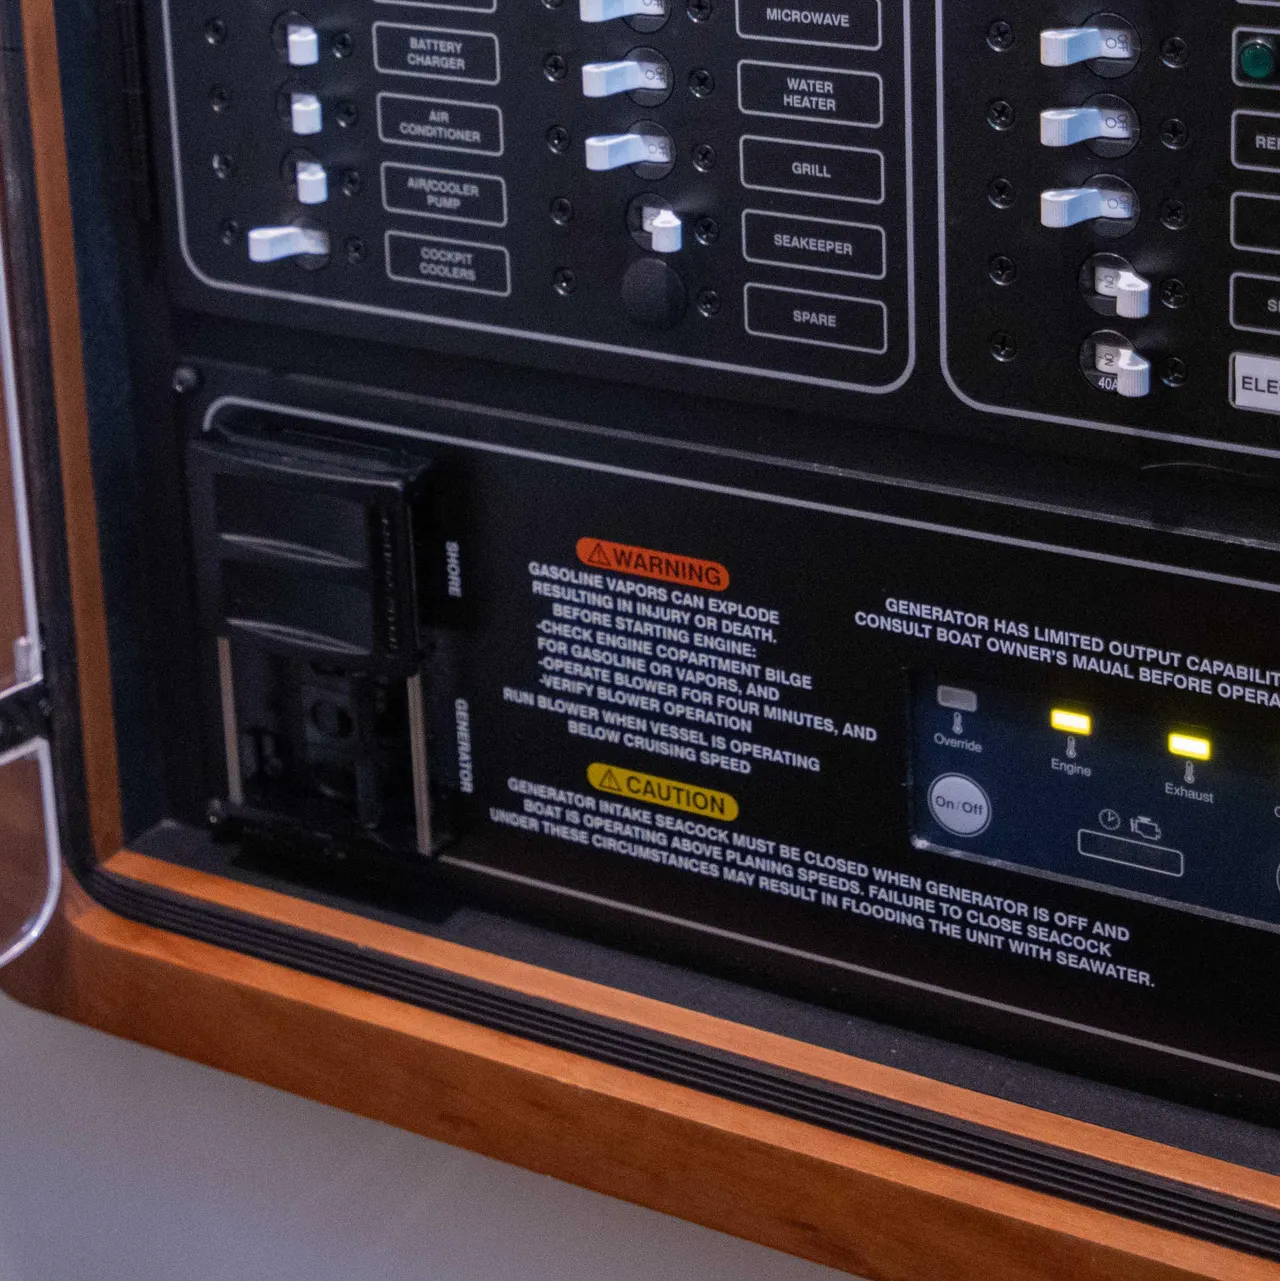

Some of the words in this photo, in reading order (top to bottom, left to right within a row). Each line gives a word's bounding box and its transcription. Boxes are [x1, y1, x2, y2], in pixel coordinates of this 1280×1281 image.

[766, 8, 850, 27] MICROWAVE
[410, 37, 463, 54] BATTERY
[407, 53, 465, 70] CHARGER
[787, 77, 833, 94] WATER
[783, 94, 837, 112] HEATER
[429, 110, 449, 123] AIR
[399, 122, 481, 143] CONDITIONER
[792, 162, 832, 178] GRILL
[407, 177, 479, 197] AIR/COOLER
[427, 195, 461, 209] PUMP
[774, 234, 853, 256] SEAKEEPER
[420, 247, 473, 265] COCKPIT
[420, 262, 476, 281] COOLERS
[793, 310, 837, 327] SPARE
[1104, 353, 1114, 366] ON
[445, 540, 462, 598] SHORE
[613, 548, 720, 586] WARNING
[528, 561, 604, 589] GASOLINE
[605, 577, 668, 602] VAPORS
[671, 591, 705, 609] CAN
[708, 598, 780, 625] EXPLODE
[885, 597, 989, 631] GENERATOR
[994, 618, 1029, 638] HAS
[1034, 626, 1104, 652] LIMITED
[1109, 640, 1182, 667] OUTPUT
[855, 611, 933, 639] CONSULT
[936, 627, 982, 649] BOAT
[986, 637, 1067, 666] OWNER'S
[1072, 654, 1134, 680] MAUAL
[1139, 667, 1213, 695] BEFORE
[454, 697, 474, 794] GENERATOR
[933, 732, 983, 754] Override
[1051, 758, 1092, 777] Engine
[626, 775, 725, 815] CAUTION
[1164, 782, 1214, 804] Exhaust
[934, 795, 984, 816] On/Off
[507, 776, 597, 810] GENERATOR
[599, 799, 652, 825] INTAKE
[655, 813, 729, 843] SEACOCK
[732, 832, 777, 855] MUST
[779, 844, 801, 862] BE
[804, 850, 869, 878] CLOSED
[872, 867, 921, 891] WHEN
[925, 880, 1029, 917] GENERATOR
[1033, 906, 1049, 922] IS
[1054, 911, 1088, 931] OFF
[1092, 921, 1130, 942] AND
